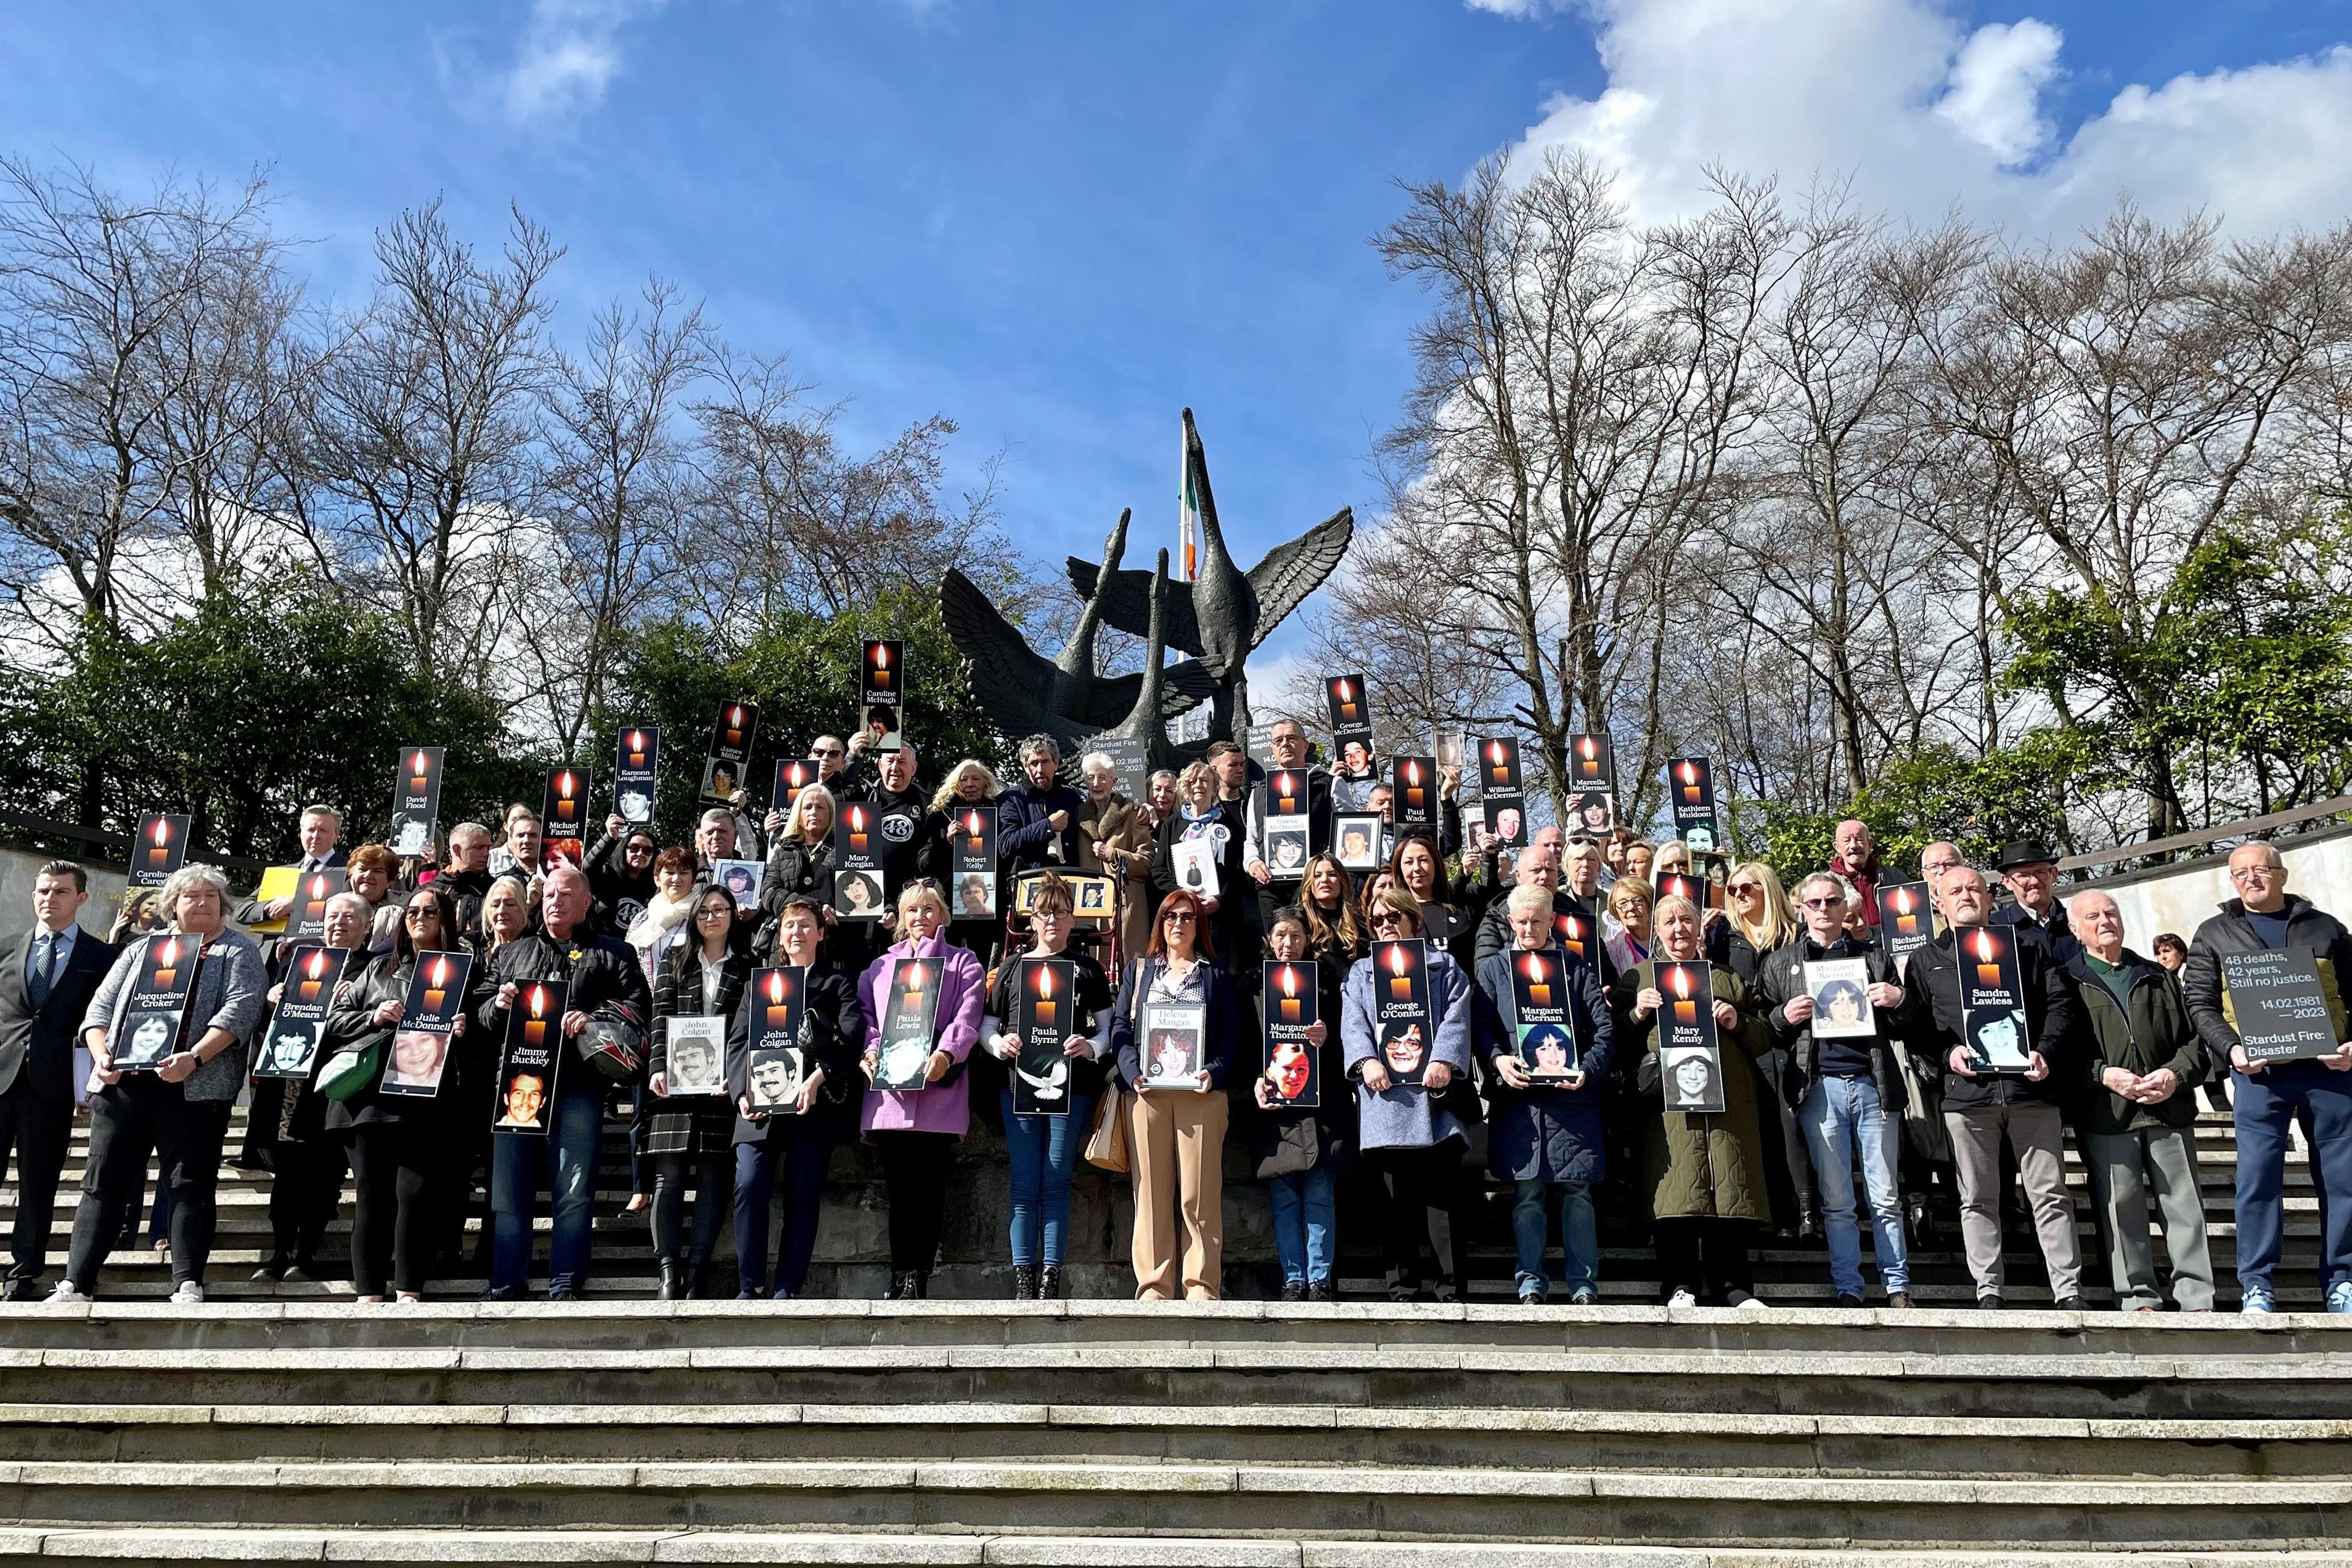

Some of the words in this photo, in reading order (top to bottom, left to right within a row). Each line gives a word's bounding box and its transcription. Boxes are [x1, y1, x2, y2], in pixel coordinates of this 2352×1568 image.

[1339, 721, 1363, 729] George
[1334, 726, 1370, 736] McDermott
[1249, 741, 1272, 749] respon
[721, 746, 742, 755] James
[721, 752, 740, 760] Millar
[1484, 791, 1522, 800] McDermott
[884, 820, 908, 835] 48
[844, 861, 874, 869] Keegan
[299, 927, 323, 935] Byrne
[1891, 934, 1926, 945] Richard
[2225, 955, 2241, 965] 48
[2244, 952, 2287, 965] deaths,
[1816, 963, 1854, 972] Margaret
[2228, 968, 2243, 976] 42
[2245, 965, 2281, 976] years,
[2231, 977, 2253, 988] Still
[2256, 977, 2271, 986] no
[2274, 973, 2316, 987] justice.
[134, 992, 184, 1000] Jacqueline
[1972, 989, 2011, 997] Sandra
[142, 1000, 174, 1008] Croker
[1972, 996, 2012, 1005] Lawless
[2260, 996, 2321, 1010] 14.02.1981
[284, 1003, 323, 1011] Brendan
[1386, 1002, 1418, 1011] George
[1159, 1009, 1187, 1017] Helena
[1381, 1010, 1425, 1019] O'Connor
[1521, 1007, 1564, 1016] Margaret
[2293, 1007, 2326, 1018] 2023
[416, 1013, 440, 1022] Julie
[896, 1015, 921, 1023] Paula
[1525, 1014, 1562, 1022] Kiernan
[401, 1020, 451, 1031] McDonnell
[1158, 1018, 1190, 1027] Mangan
[682, 1028, 711, 1037] Colgan
[1032, 1027, 1058, 1035] Paula
[1270, 1023, 1310, 1033] Margare
[1674, 1026, 1699, 1036] Mary
[764, 1031, 788, 1039] John
[1270, 1031, 1309, 1039] Thornto
[1672, 1035, 1703, 1044] Kenny
[2244, 1032, 2297, 1045] Stardust
[2298, 1031, 2325, 1040] Fire:
[759, 1038, 791, 1048] Colgan
[1031, 1035, 1058, 1045] Byrne
[515, 1047, 548, 1056] Jimmy
[2248, 1045, 2298, 1056] Disaster
[512, 1055, 549, 1067] Buckley
